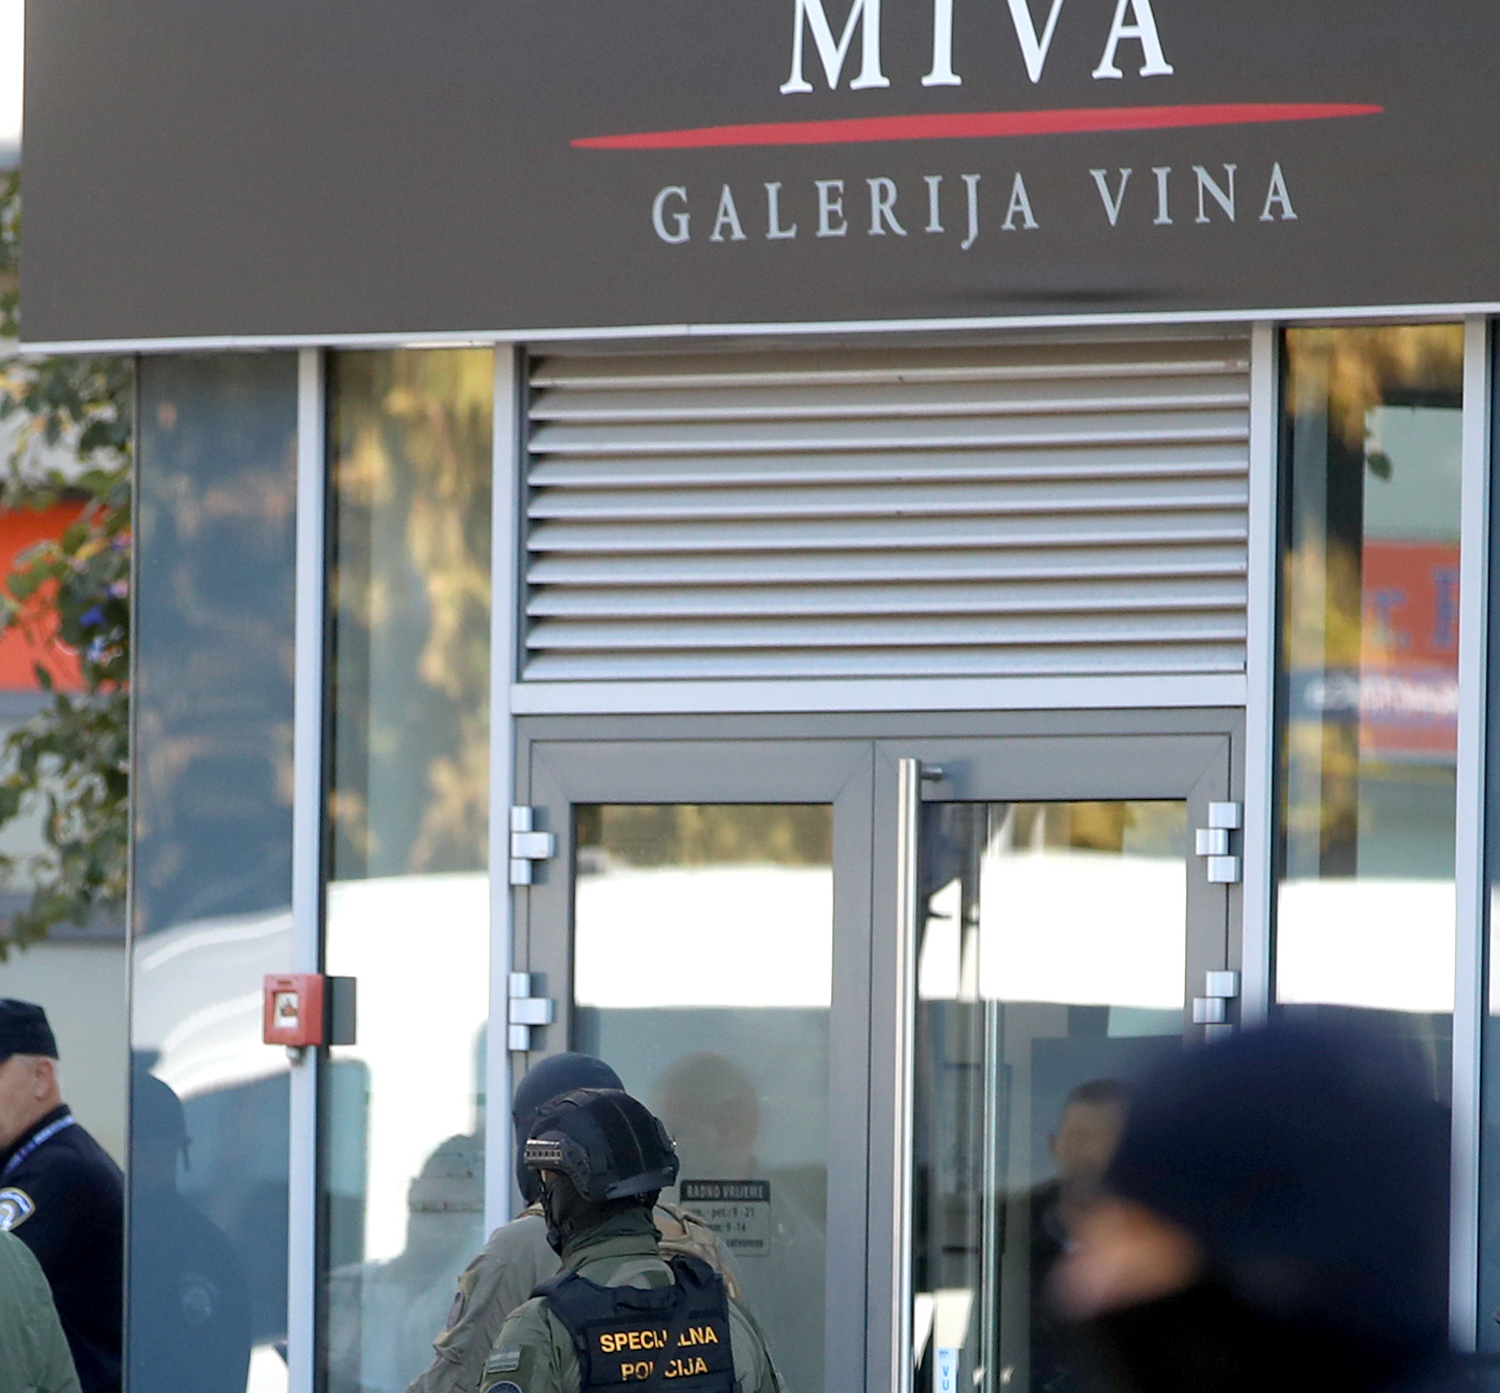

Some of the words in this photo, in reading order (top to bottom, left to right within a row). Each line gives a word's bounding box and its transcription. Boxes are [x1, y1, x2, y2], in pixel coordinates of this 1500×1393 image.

[779, 0, 1174, 94] MIVA
[652, 171, 1041, 250] GALERIJA
[1089, 161, 1299, 227] VINA
[599, 1325, 719, 1353] SPECIJLNA
